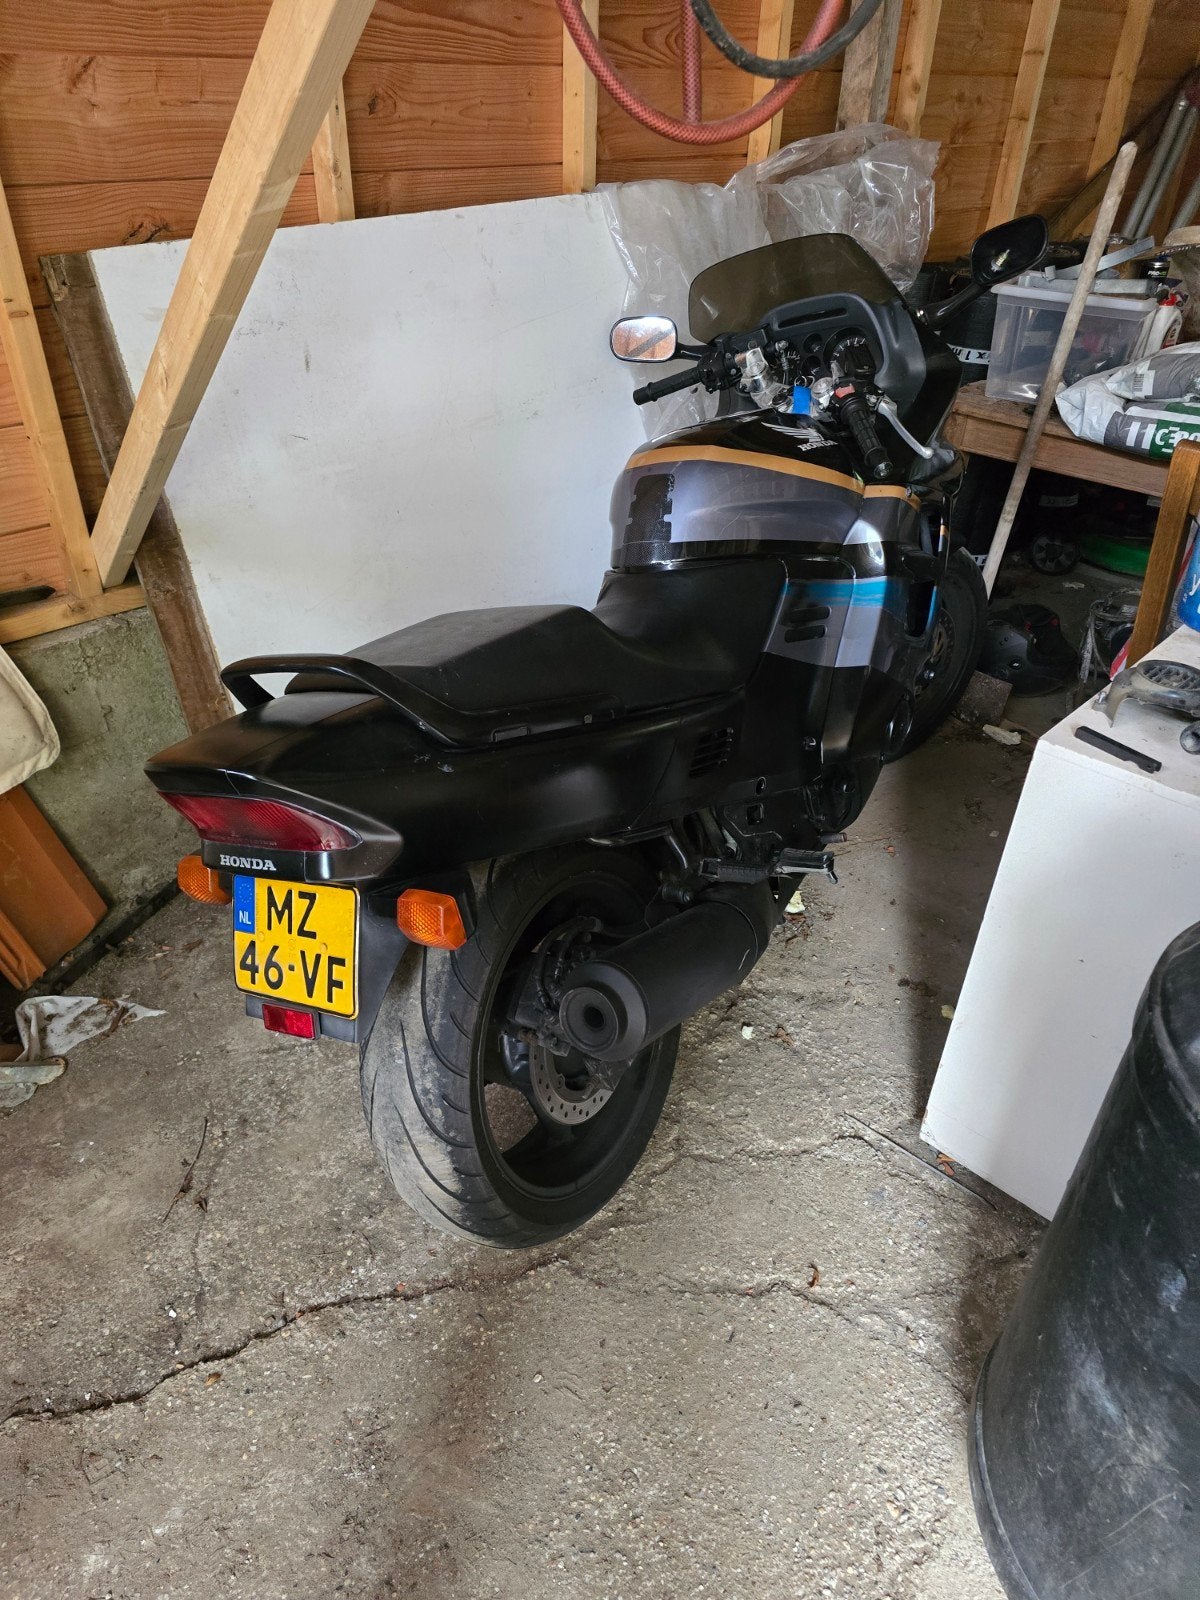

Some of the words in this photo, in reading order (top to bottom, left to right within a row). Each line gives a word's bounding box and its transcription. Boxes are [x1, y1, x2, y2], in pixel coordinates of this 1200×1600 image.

[797, 440, 839, 452] HONDA
[219, 854, 277, 871] HONDA
[238, 910, 252, 925] NL
[266, 886, 318, 940] MZ
[239, 940, 346, 1003] 46-VF
